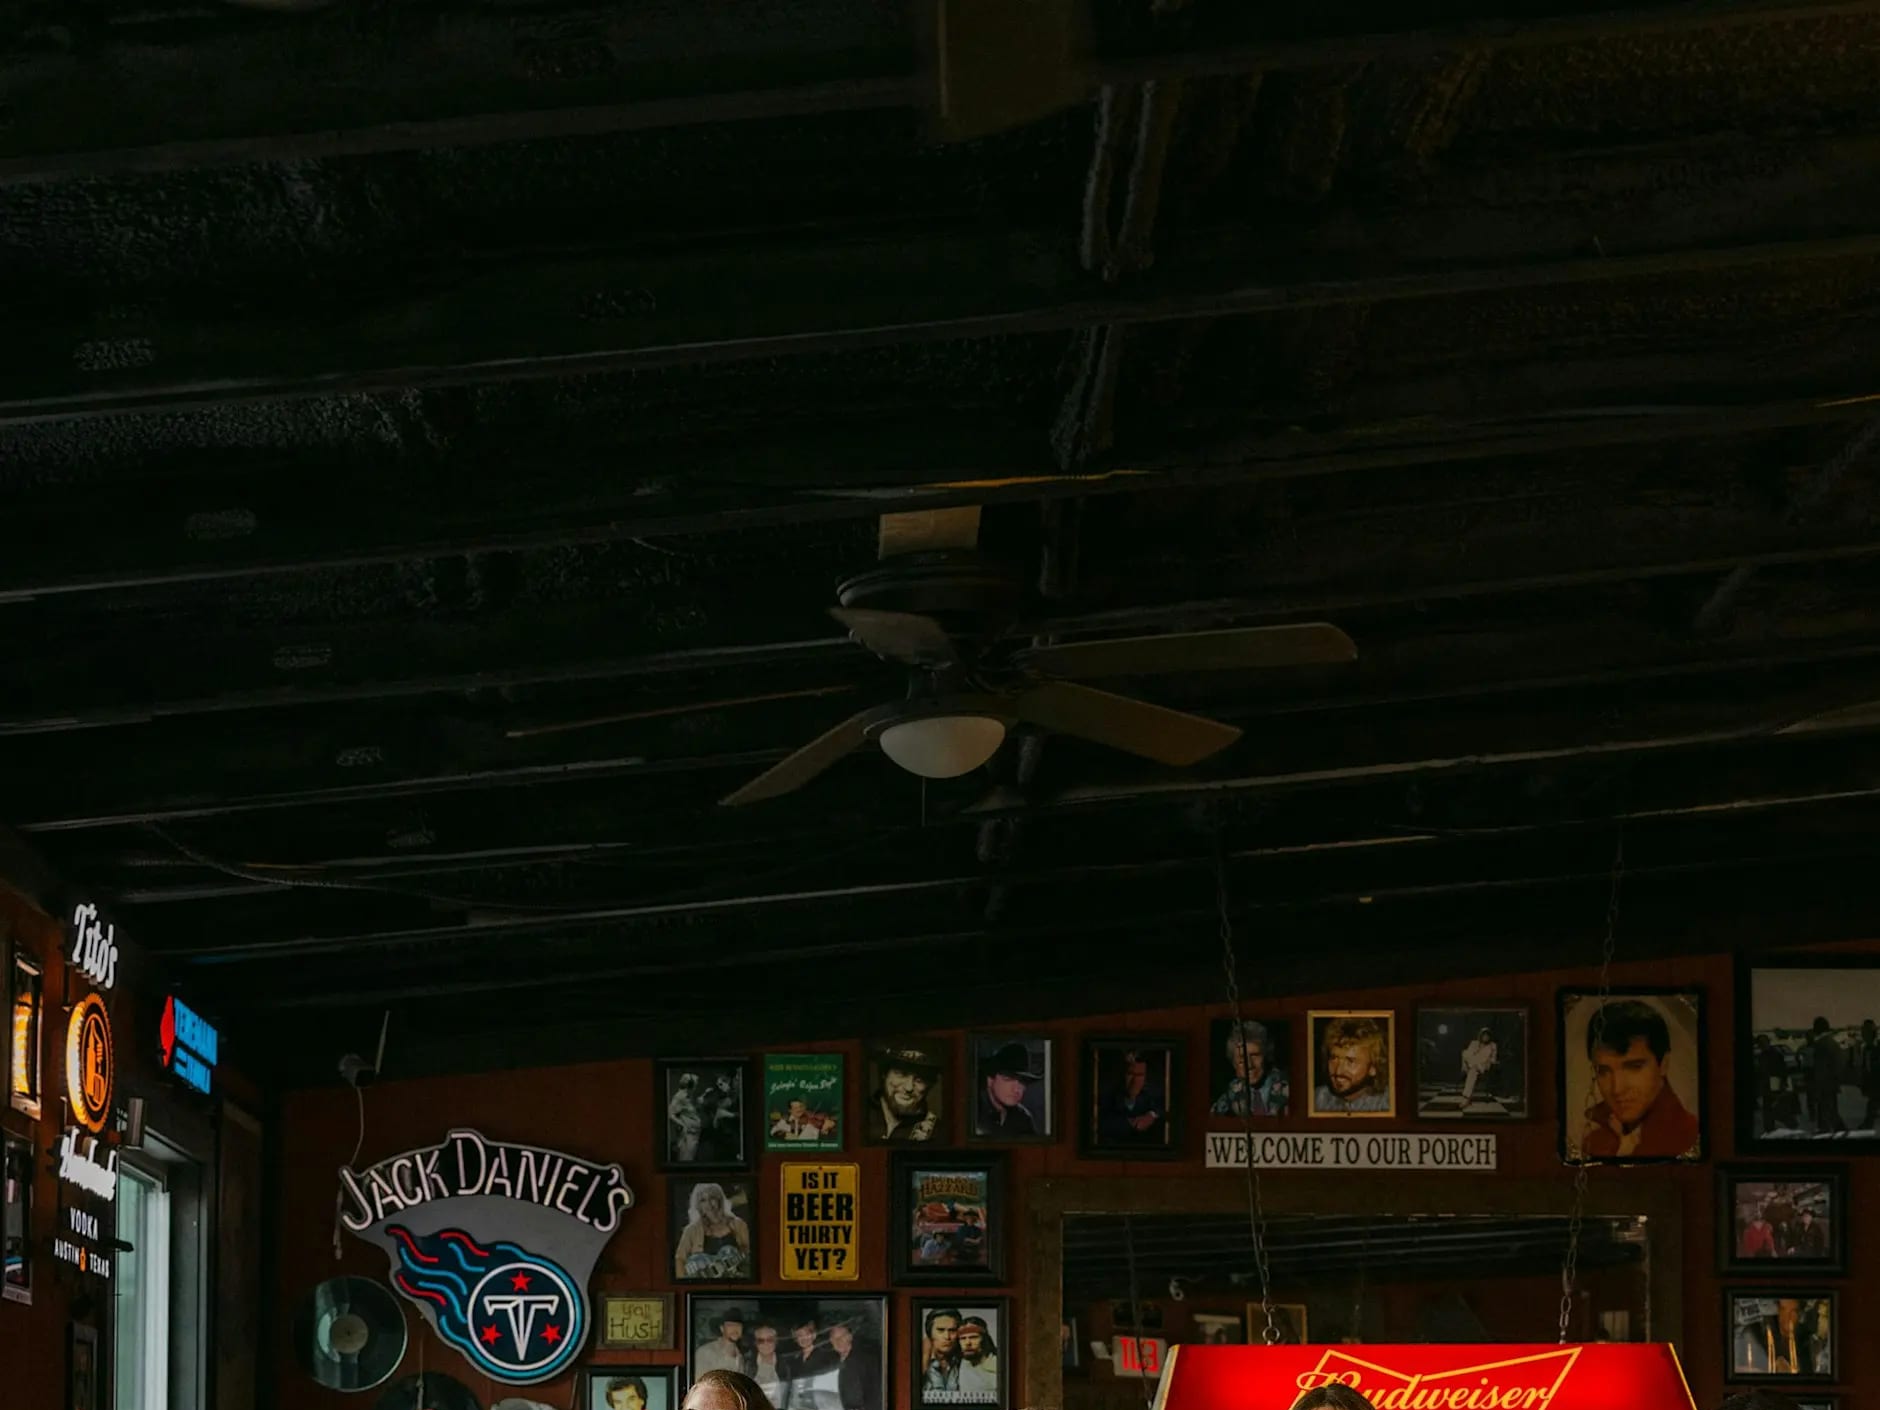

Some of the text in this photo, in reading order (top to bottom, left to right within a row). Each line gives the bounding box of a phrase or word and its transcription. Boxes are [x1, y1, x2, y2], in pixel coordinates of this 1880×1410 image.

[72, 903, 118, 989] Tito's
[1330, 1137, 1360, 1164] TO
[1367, 1137, 1413, 1165] OUR
[1418, 1138, 1491, 1166] PORCH
[342, 1149, 450, 1230] JACK
[801, 1171, 838, 1189] IS IT
[786, 1193, 853, 1222] BEER
[70, 1207, 98, 1241] VODKA
[786, 1225, 852, 1244] THIRTY
[54, 1238, 110, 1279] AUSTIN TEXAS
[795, 1248, 847, 1270] YET?
